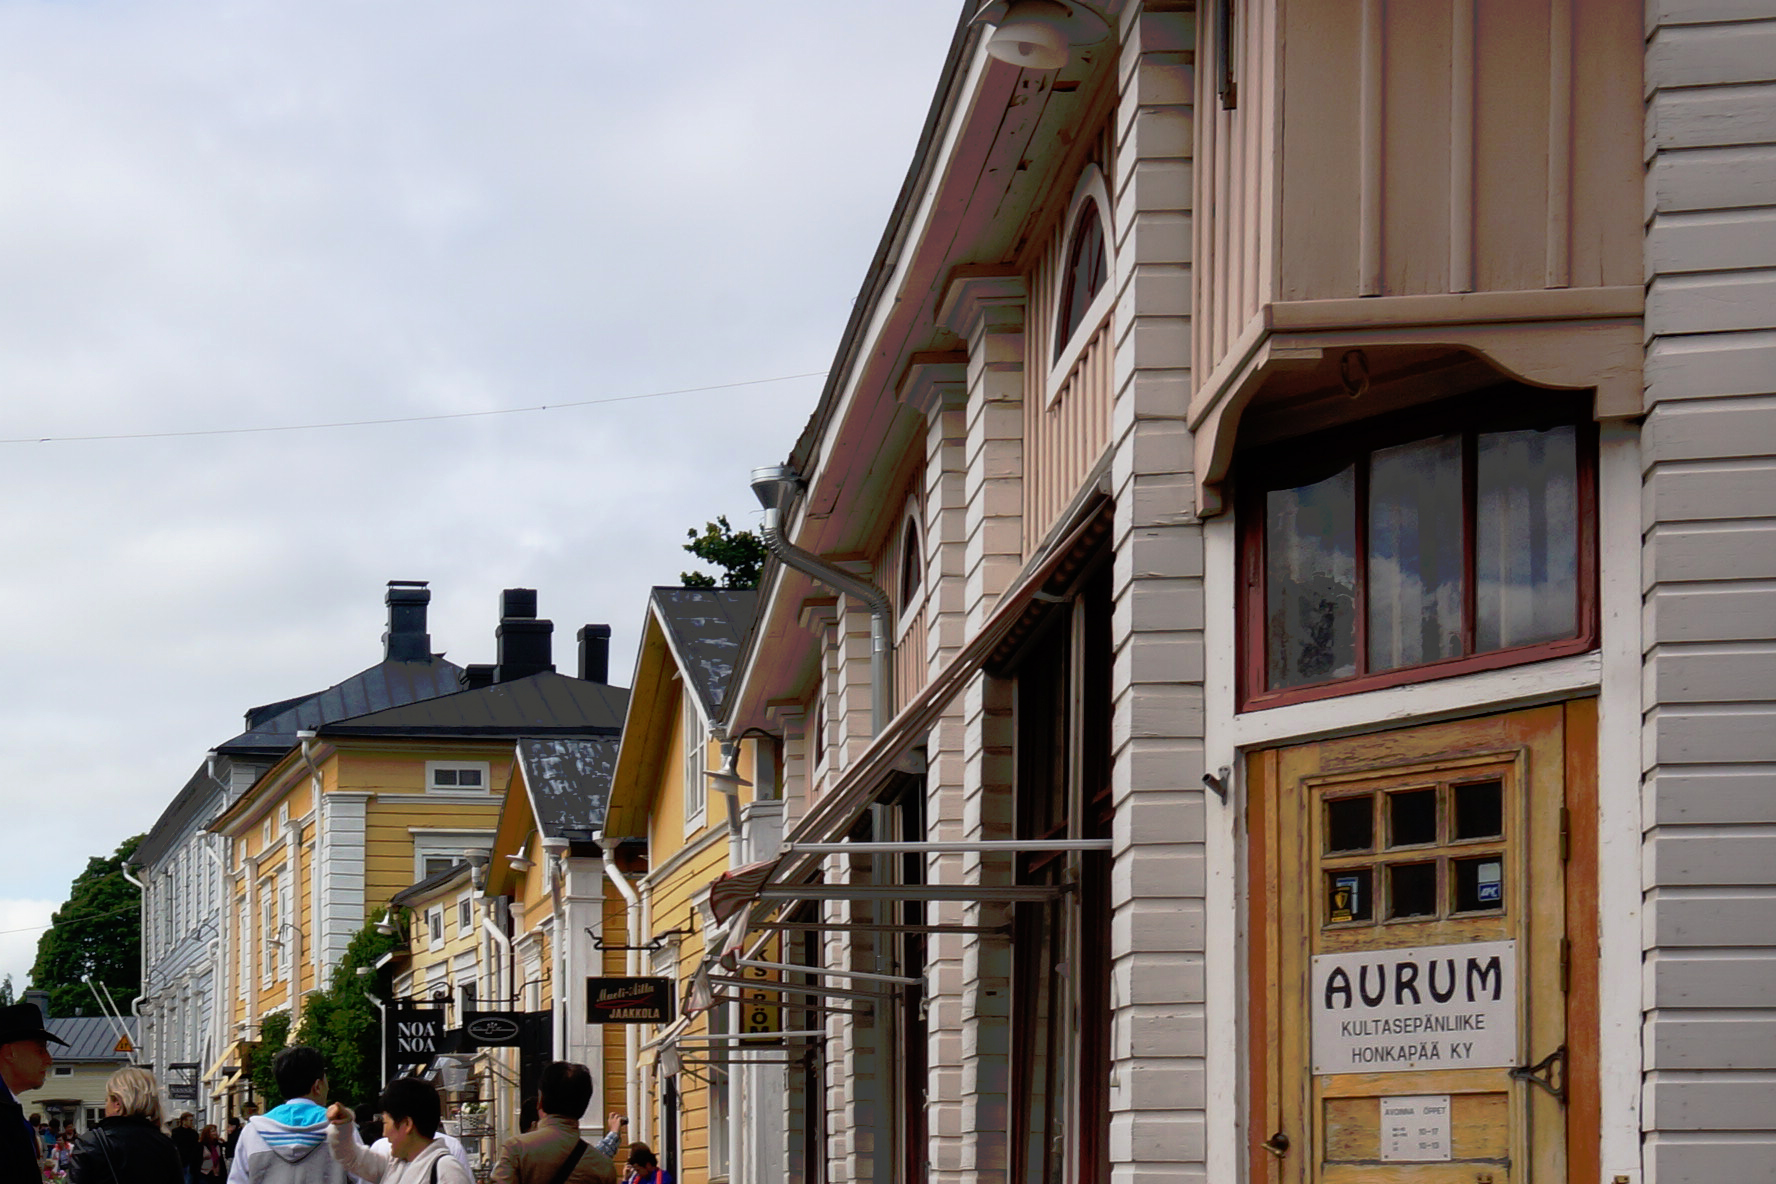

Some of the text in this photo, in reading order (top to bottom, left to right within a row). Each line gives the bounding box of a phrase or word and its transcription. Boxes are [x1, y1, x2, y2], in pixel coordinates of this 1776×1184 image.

[1325, 956, 1502, 1009] AURUM
[609, 1008, 661, 1019] JAAKKOLA
[397, 1021, 435, 1037] NOA
[1341, 1013, 1486, 1038] KULTASEPÄNLIIKE
[397, 1038, 436, 1052] NOA
[1352, 1041, 1473, 1064] HONKAPÄÄ KY
